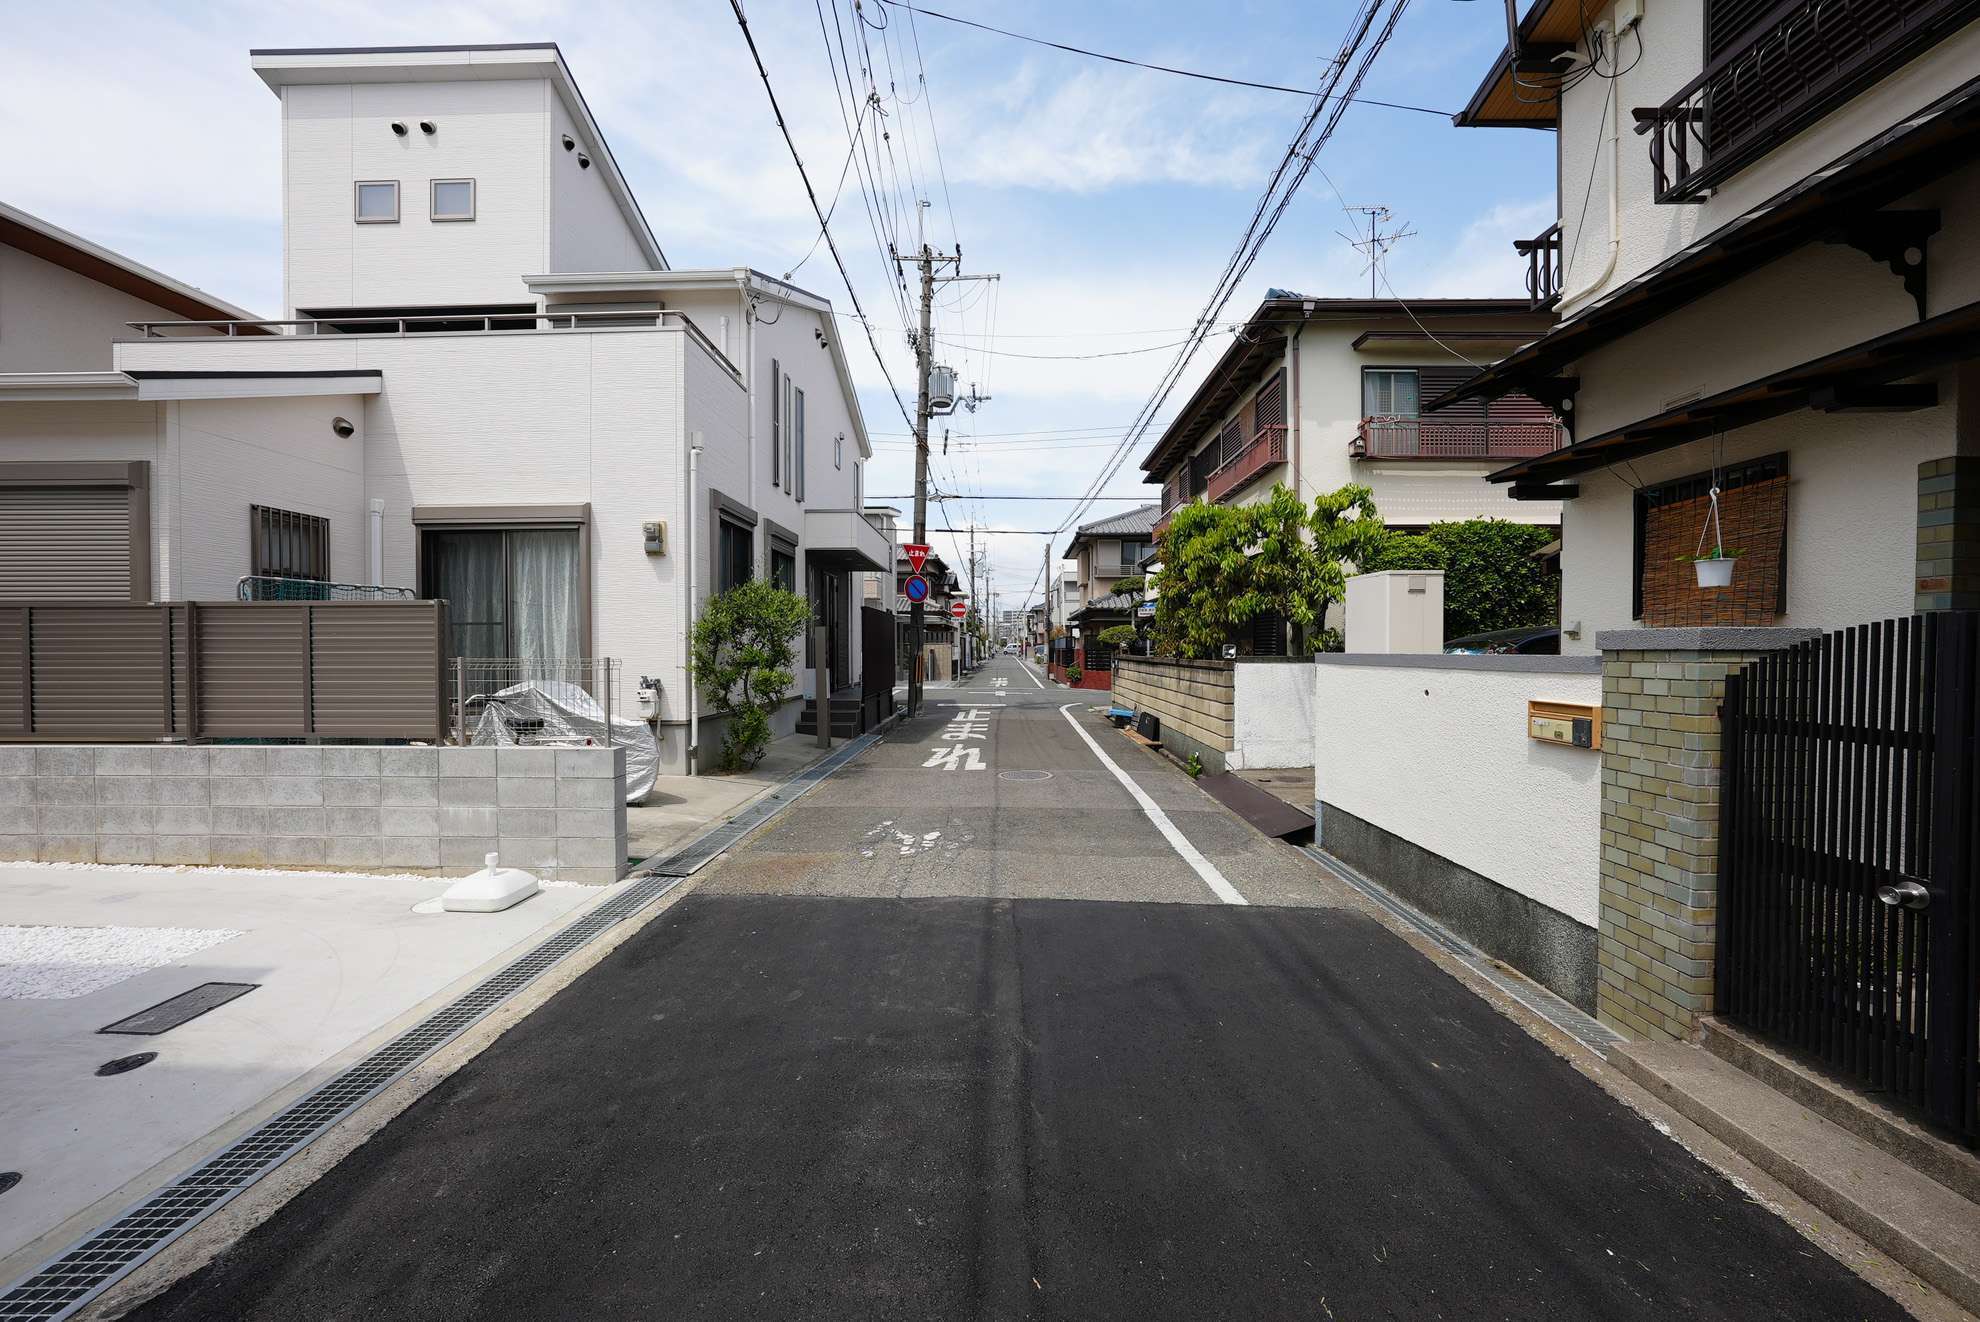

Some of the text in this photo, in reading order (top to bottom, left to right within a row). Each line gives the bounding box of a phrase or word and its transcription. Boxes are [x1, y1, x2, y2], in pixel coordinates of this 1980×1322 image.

[908, 549, 926, 557] 止まれ
[921, 709, 991, 770] 止まれ
